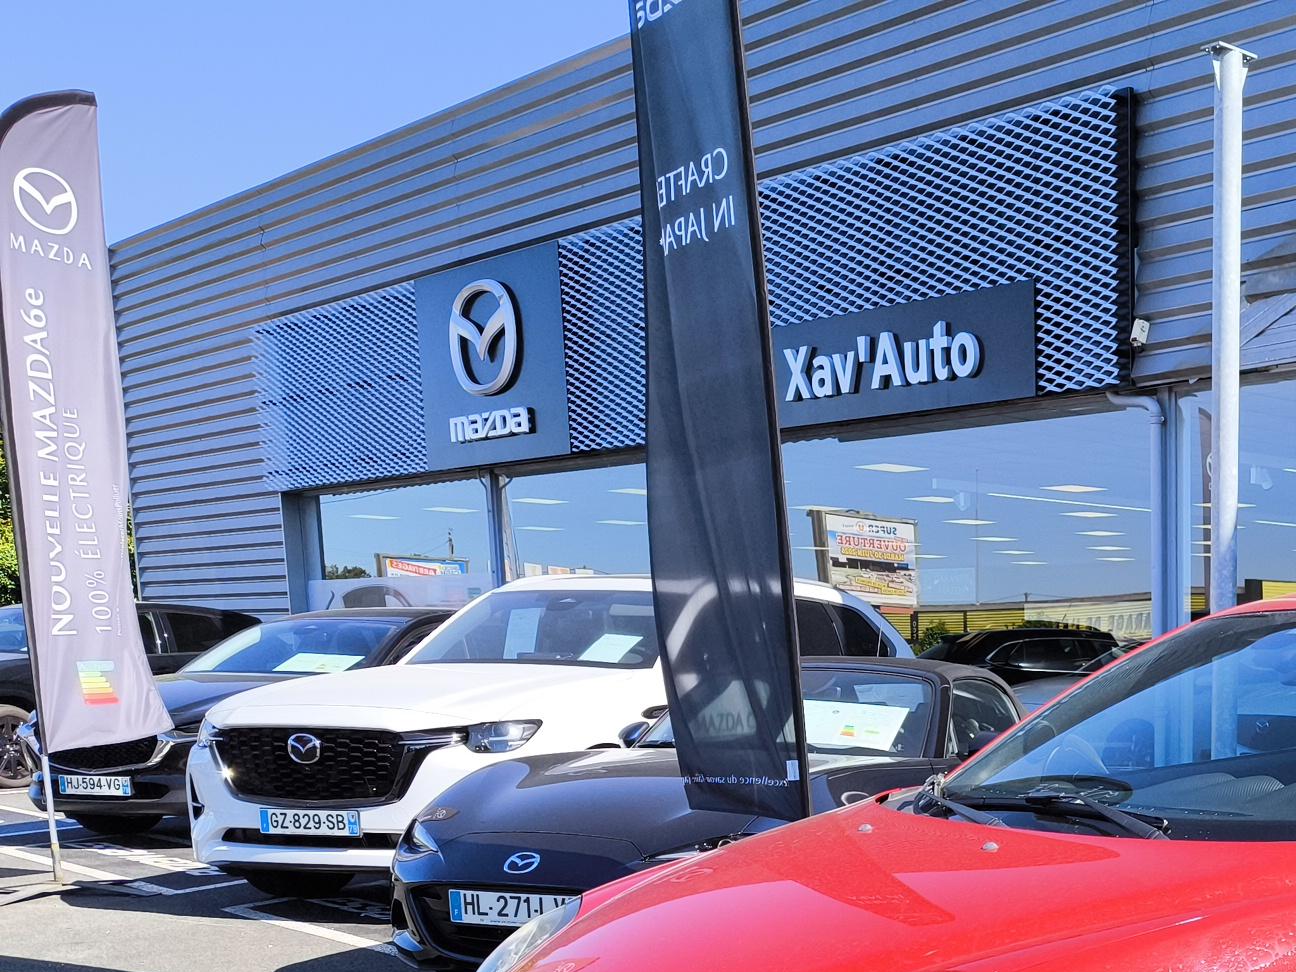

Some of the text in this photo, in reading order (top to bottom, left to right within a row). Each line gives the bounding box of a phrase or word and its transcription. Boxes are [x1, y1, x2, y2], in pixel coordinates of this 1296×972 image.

[9, 232, 92, 270] MAZDA
[783, 320, 980, 402] Xav'Auto
[450, 406, 531, 443] mazda
[20, 287, 78, 637] NOUVELLE MAZDA6e
[62, 407, 113, 633] 100% ÉLECTRIQUE
[66, 777, 121, 790] HJ-594-VG
[270, 812, 346, 831] GZ-829-SB
